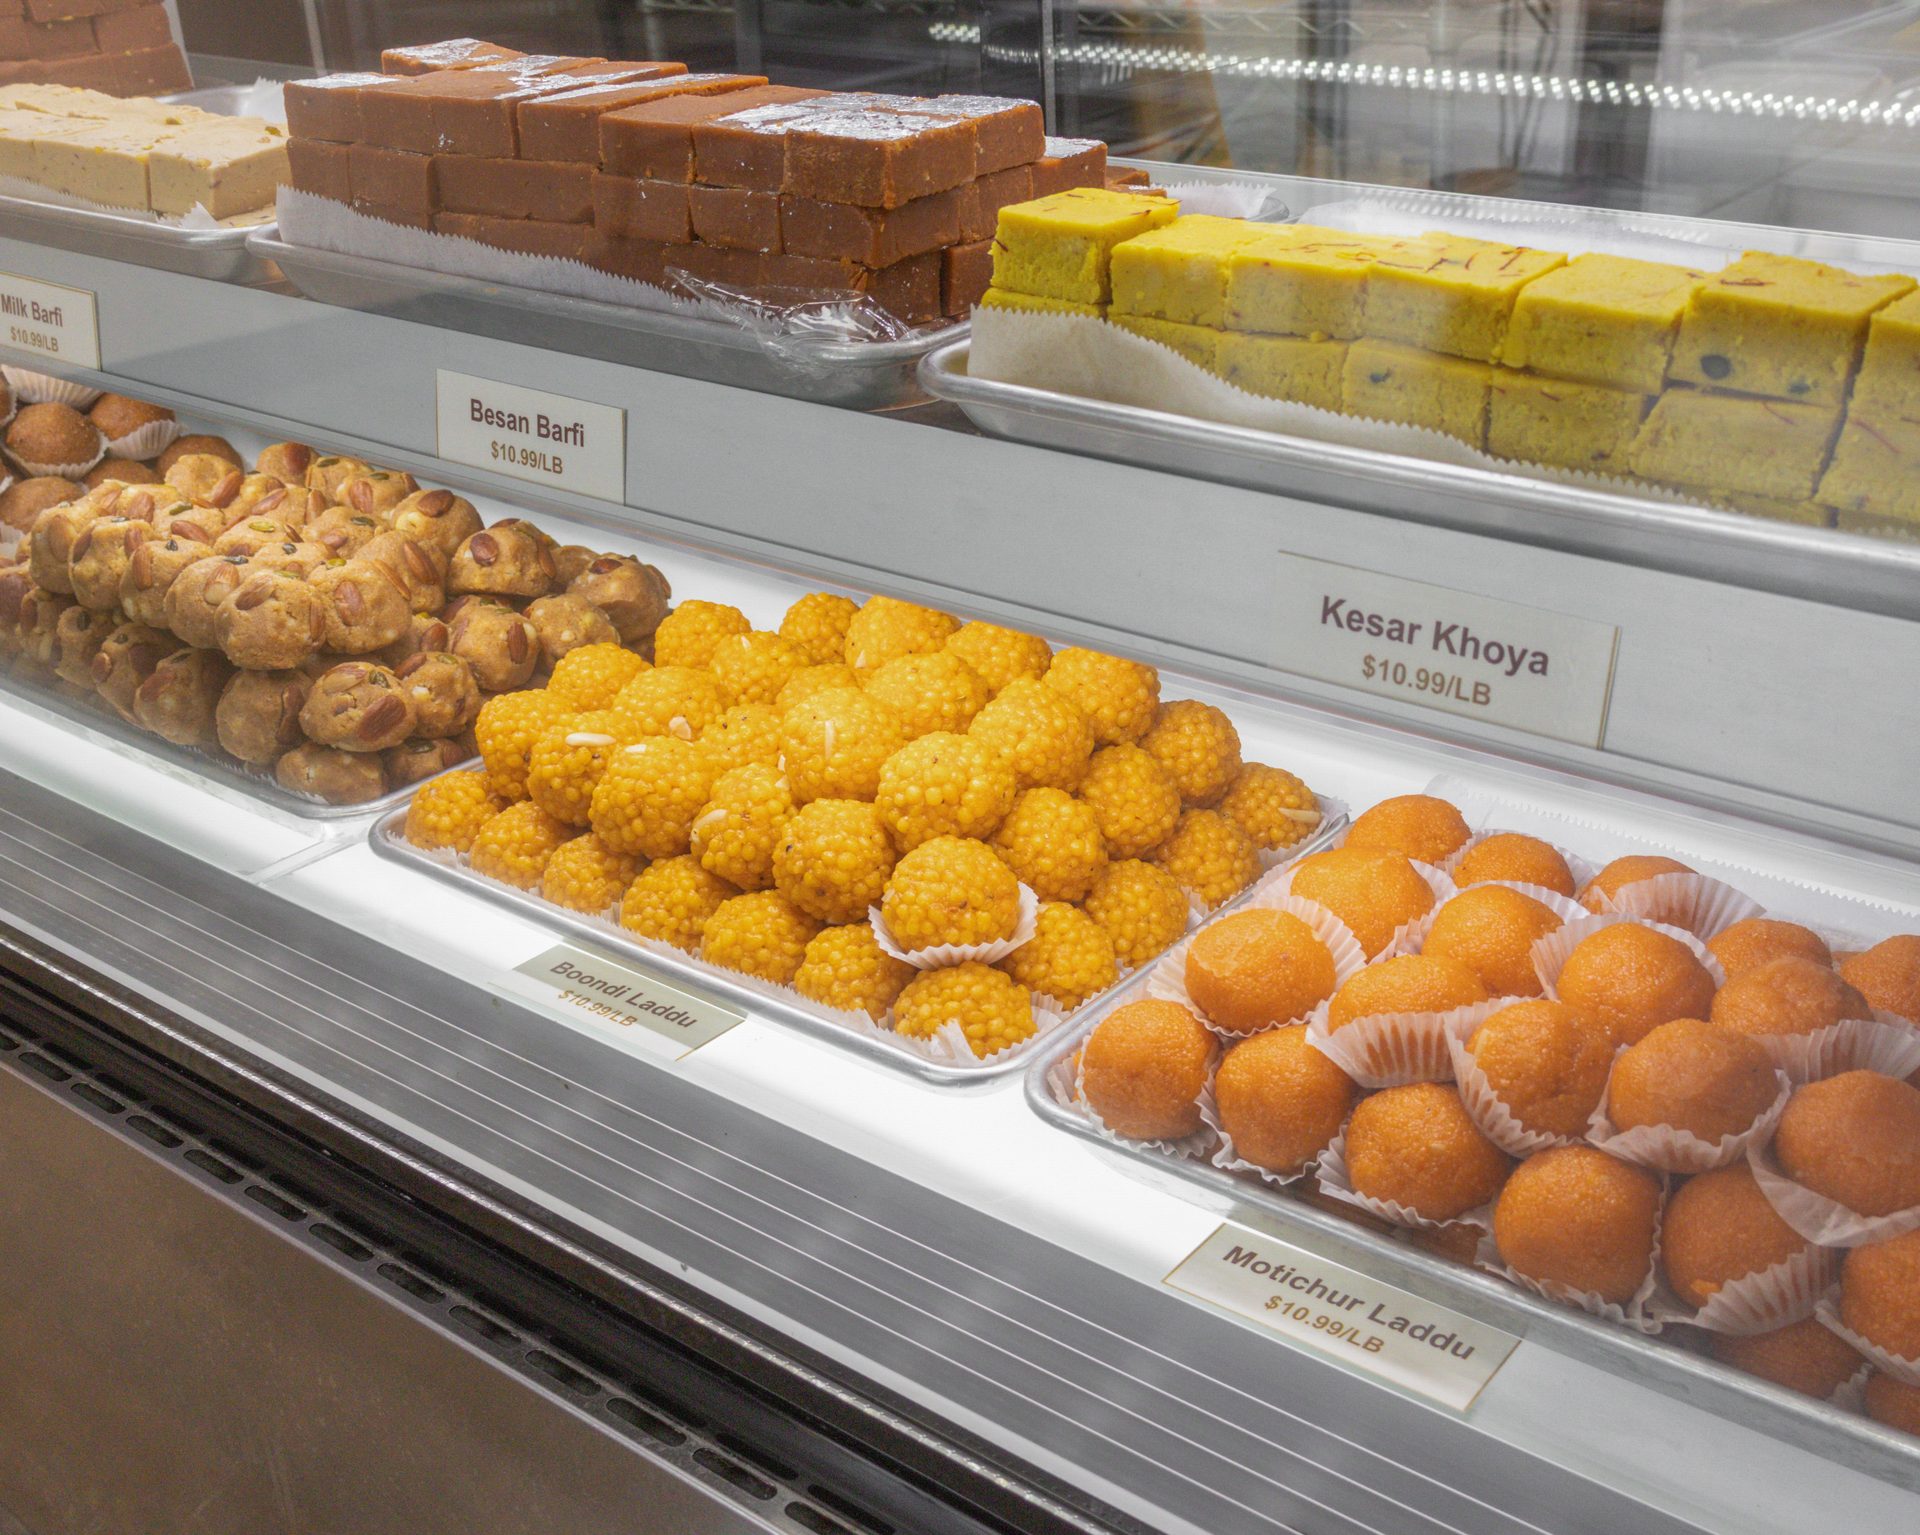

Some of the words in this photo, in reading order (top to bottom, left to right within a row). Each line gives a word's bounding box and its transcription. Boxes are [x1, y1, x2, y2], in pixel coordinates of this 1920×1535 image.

[1, 293, 28, 318] Milk
[31, 301, 63, 327] Barfi
[10, 326, 59, 352] $10.99/LB
[470, 398, 530, 434] Besan
[537, 414, 585, 448] Barfi
[491, 440, 563, 475] $10.99/LB
[1321, 595, 1422, 645] Kesar
[1432, 620, 1549, 677] Khoya
[1362, 654, 1492, 706] $10.99/LB
[550, 961, 631, 998] Boondi
[625, 992, 697, 1028] Laddu
[558, 989, 638, 1028] $10.99/LB
[1222, 1245, 1365, 1312] Motichur
[1367, 1303, 1476, 1360] Laddu
[1264, 1295, 1386, 1354] $10.99/LB
